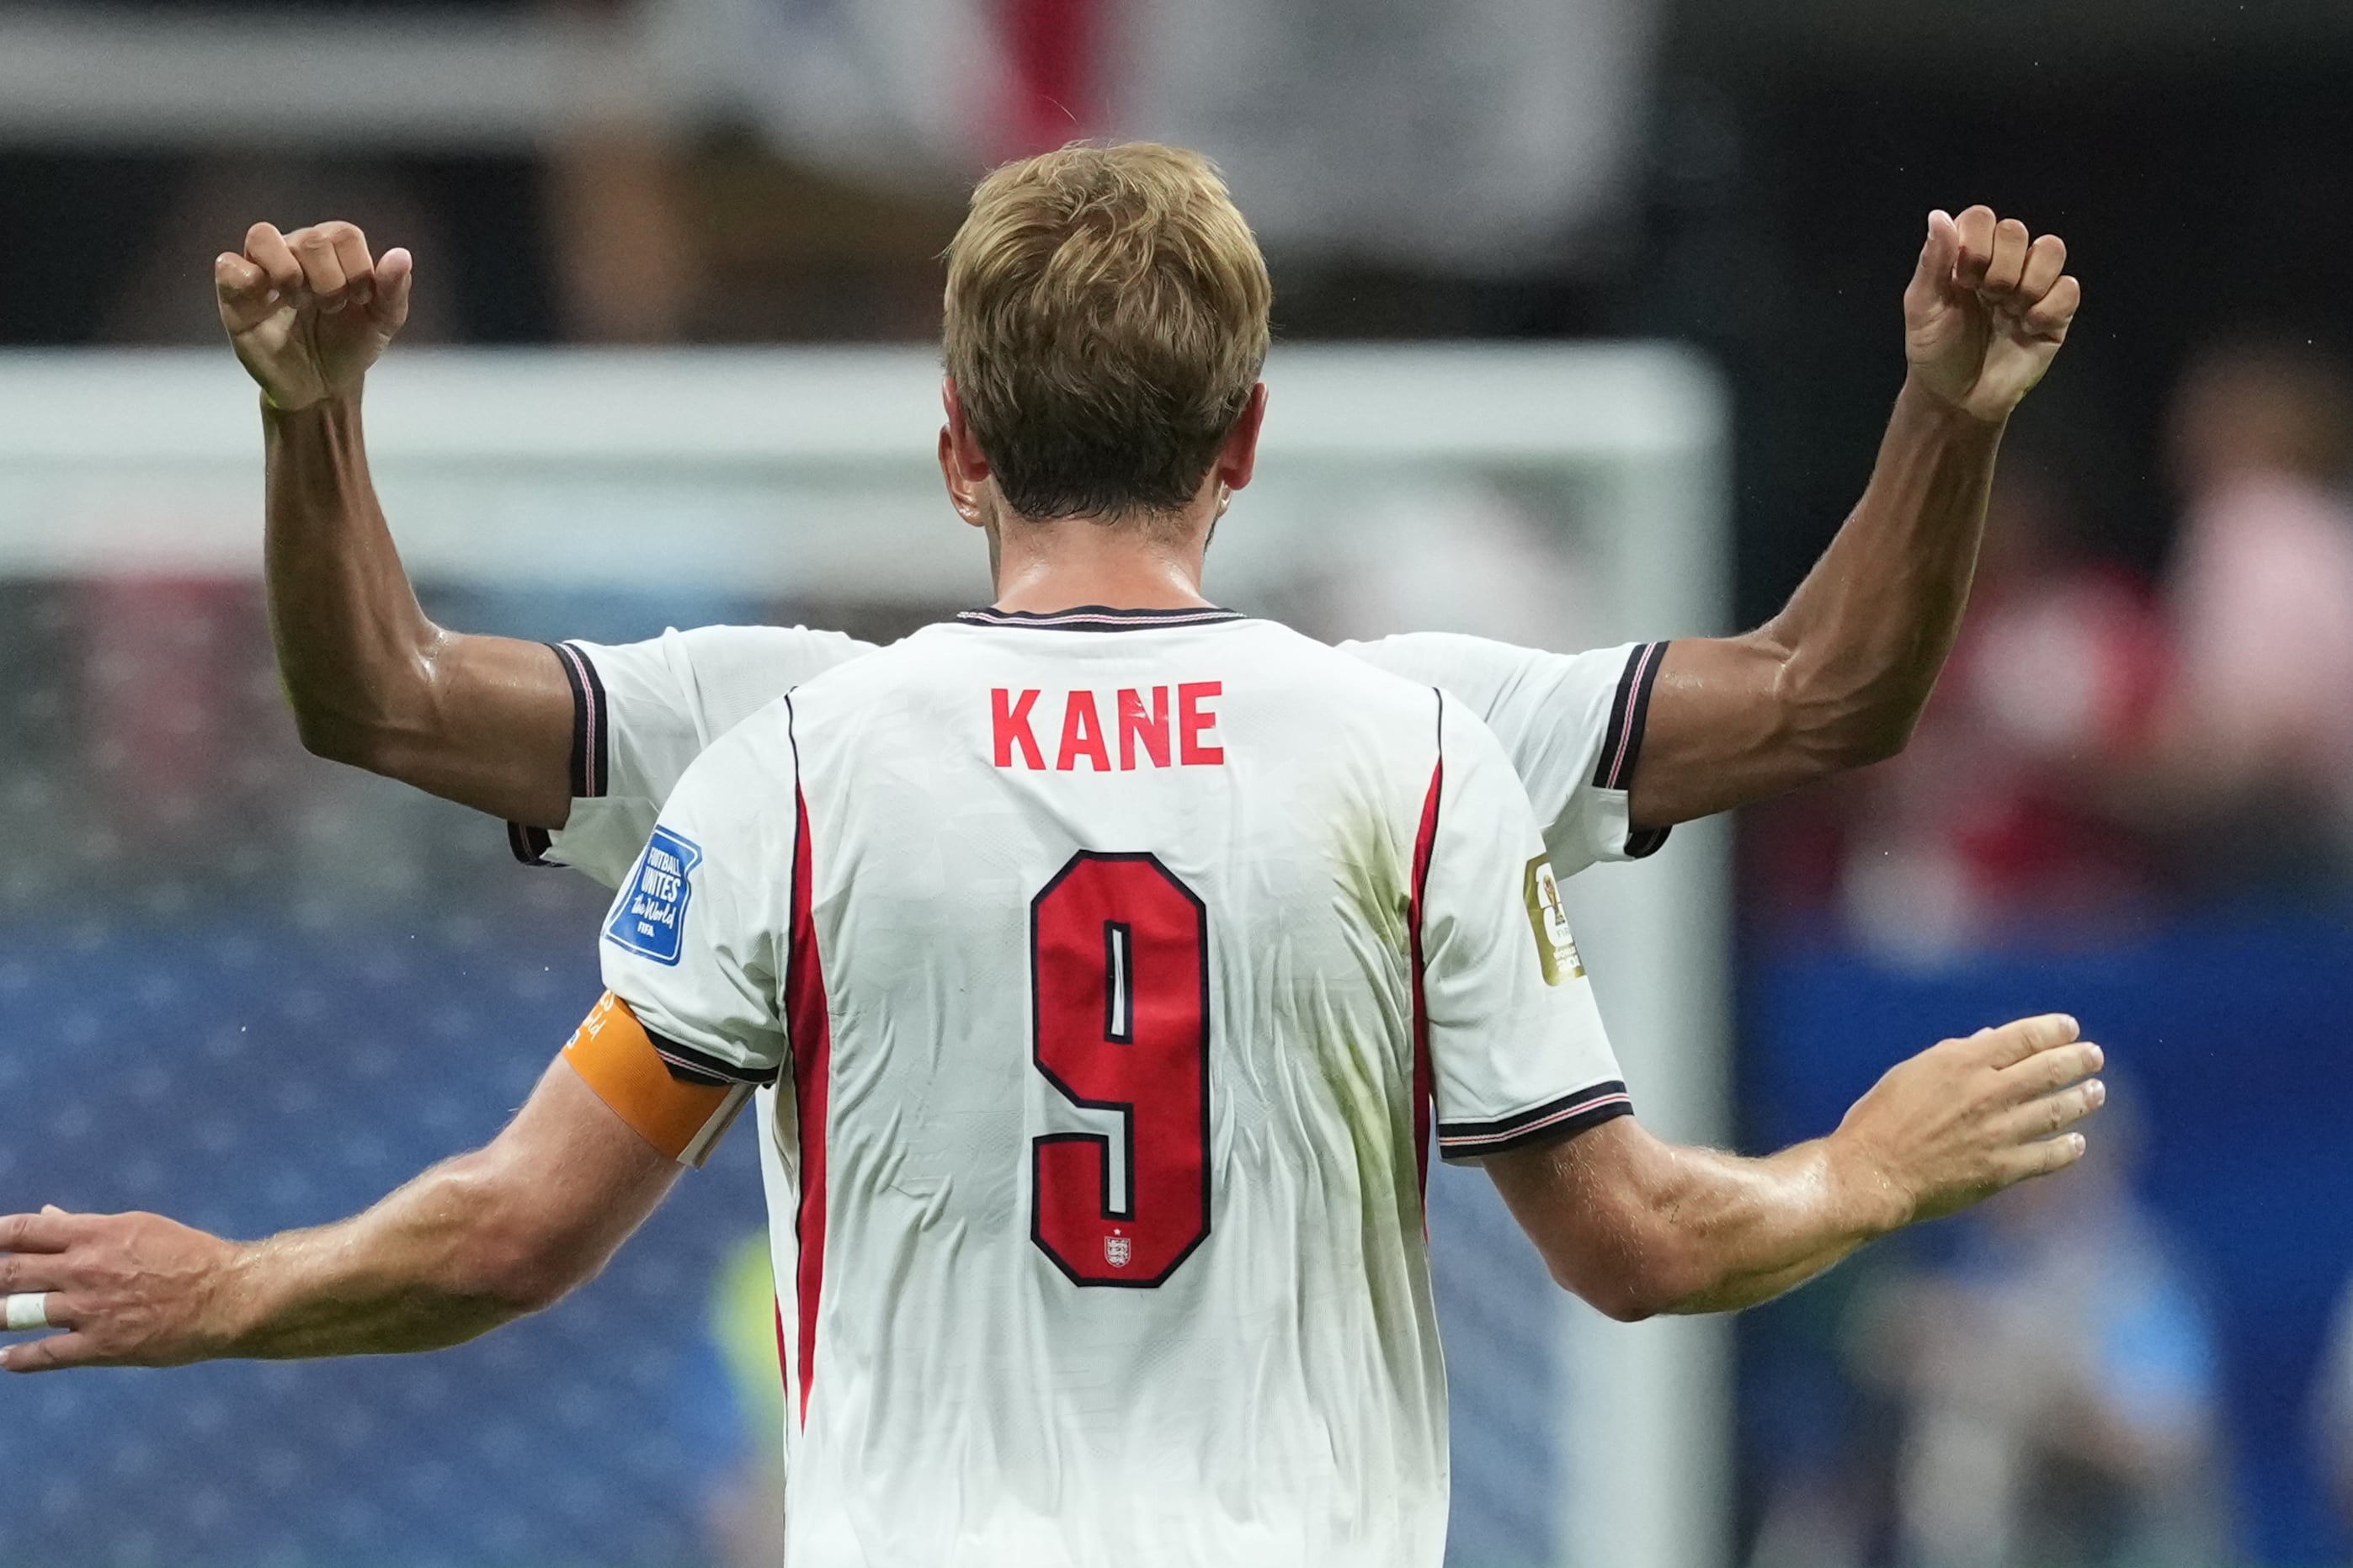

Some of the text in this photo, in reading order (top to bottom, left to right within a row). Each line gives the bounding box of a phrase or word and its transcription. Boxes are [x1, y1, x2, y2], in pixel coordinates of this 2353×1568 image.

[991, 680, 1224, 772] KANE
[647, 847, 682, 878] FOOTBALL
[641, 865, 681, 903] UNITES
[631, 893, 677, 930] the World
[637, 921, 655, 938] FIFA
[1031, 849, 1211, 1288] 9
